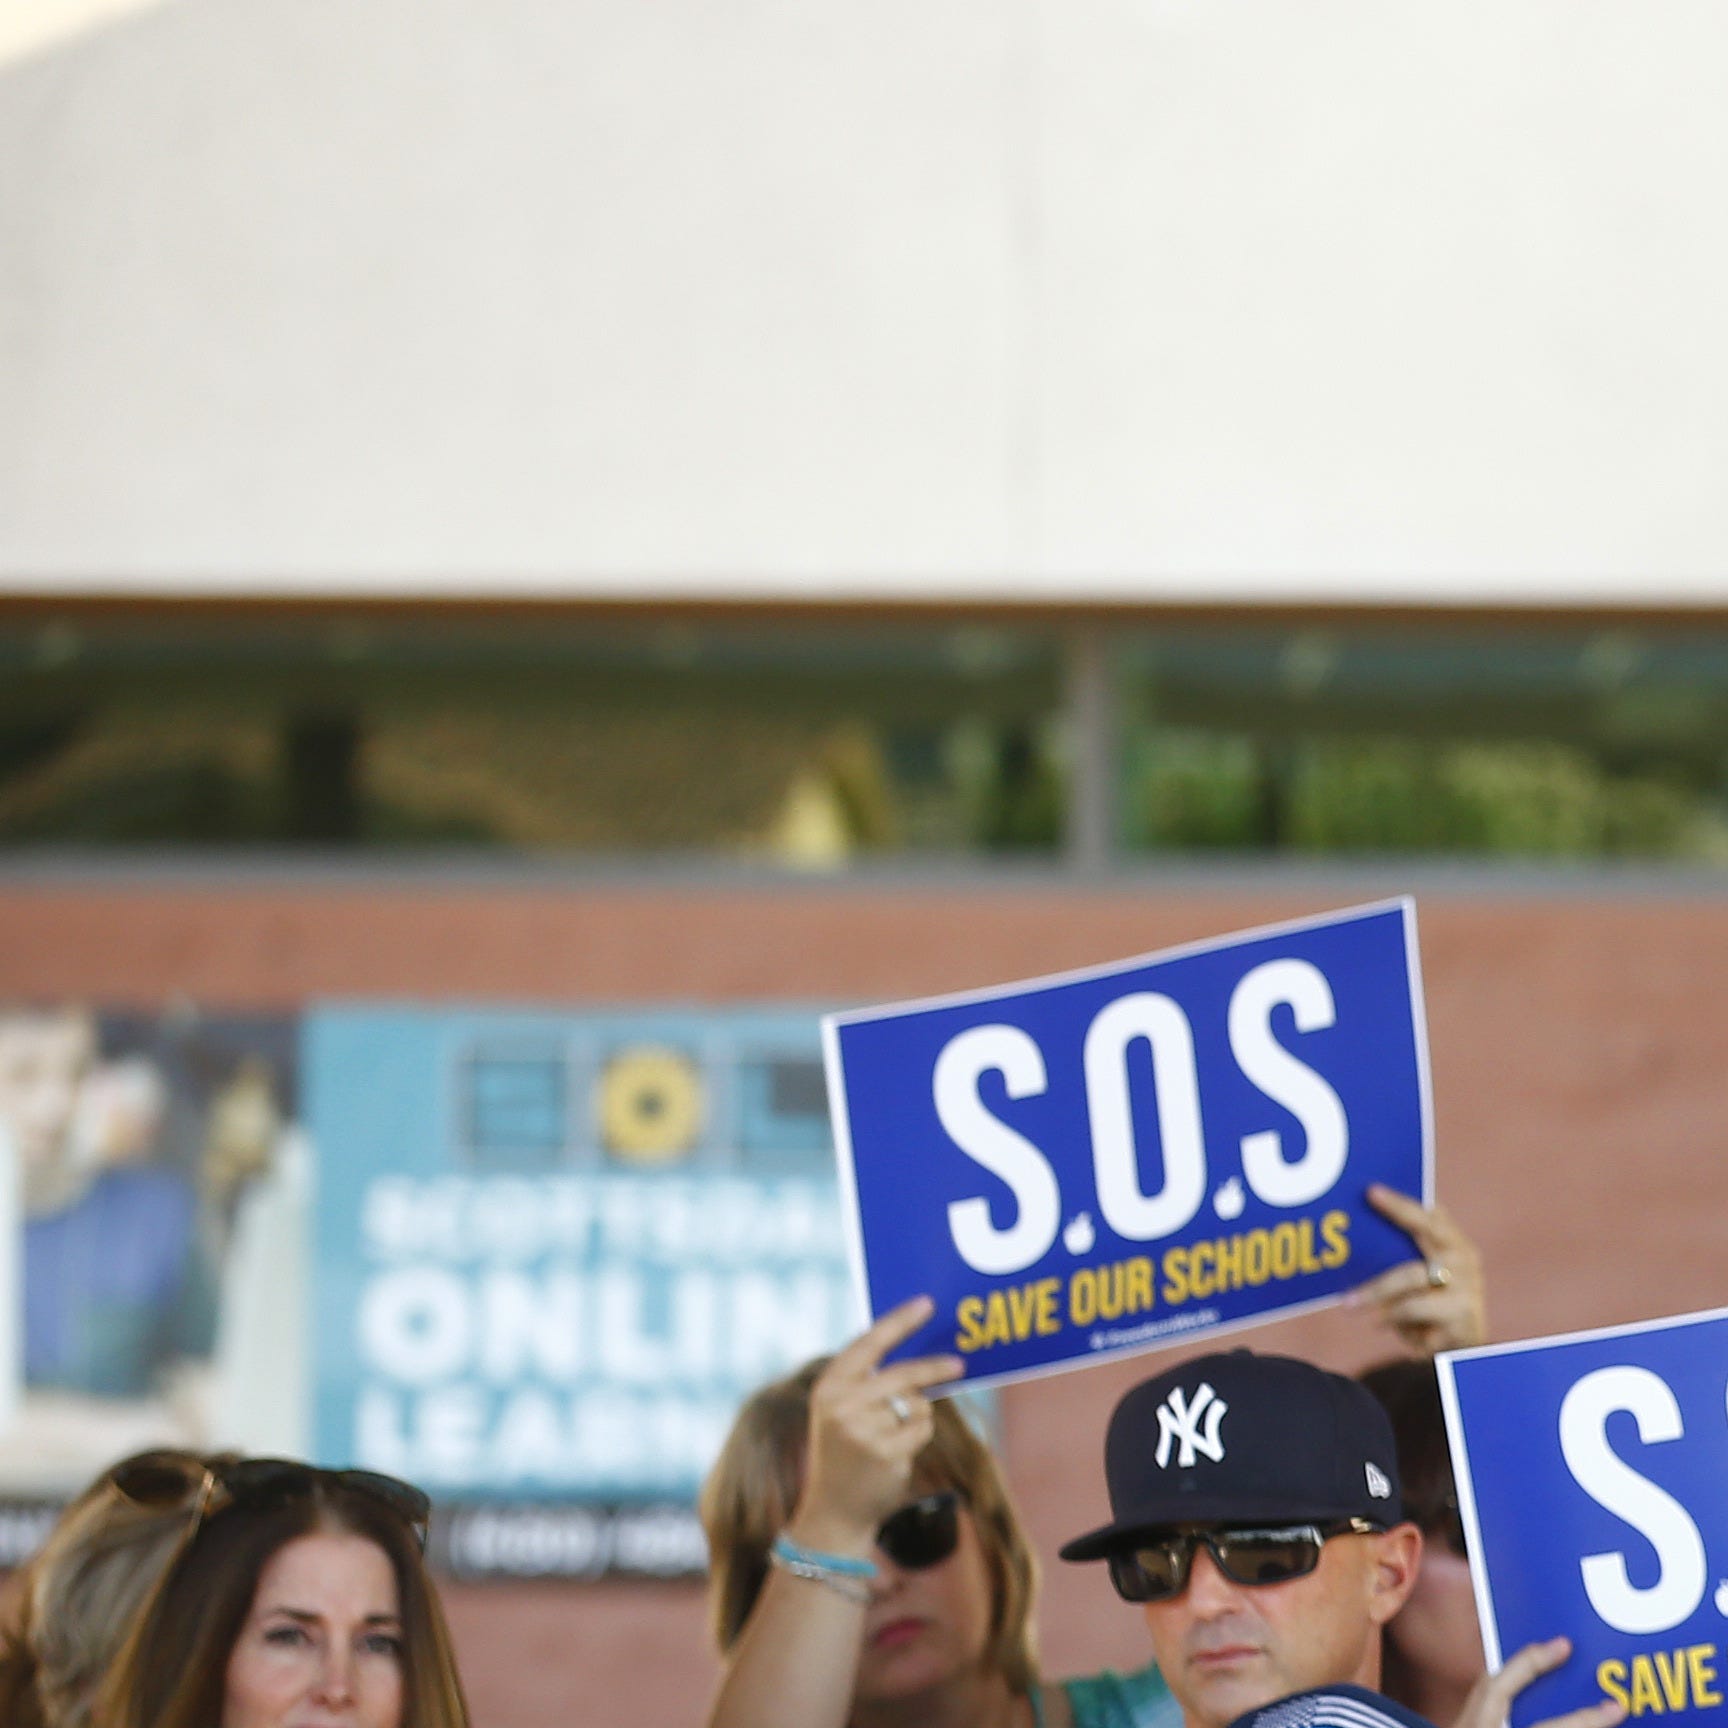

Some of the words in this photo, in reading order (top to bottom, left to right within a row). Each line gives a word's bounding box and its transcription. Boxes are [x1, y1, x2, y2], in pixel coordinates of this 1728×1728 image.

[932, 957, 1350, 1276] S.O.S
[955, 1277, 1063, 1353] SAVE
[1070, 1256, 1155, 1327] OUR
[1162, 1212, 1350, 1305] SCHOOLS
[1597, 1643, 1724, 1717] SAVE
